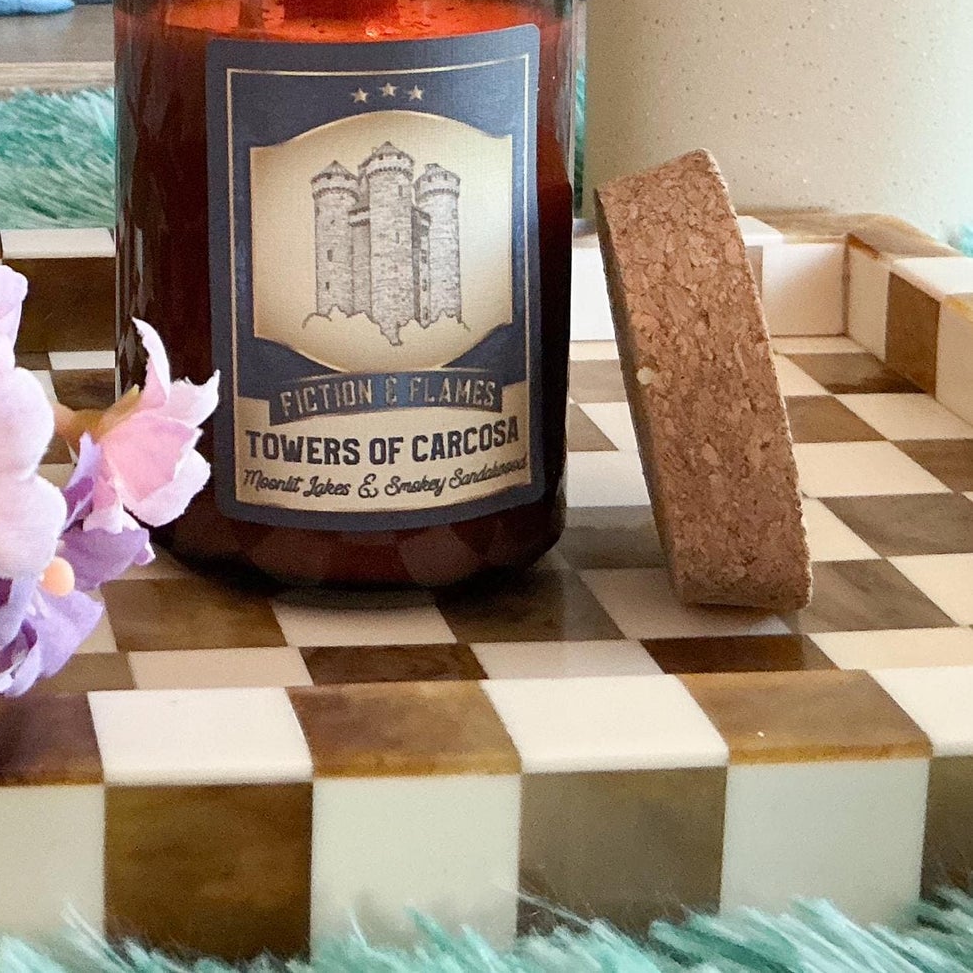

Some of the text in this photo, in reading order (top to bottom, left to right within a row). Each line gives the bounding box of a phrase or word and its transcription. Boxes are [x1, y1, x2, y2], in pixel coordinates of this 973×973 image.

[280, 379, 374, 416] FICTION
[410, 377, 495, 407] FLAMES
[245, 415, 520, 466] TOWERS OF CARCOSA
[243, 469, 303, 493] Moonlit
[303, 475, 351, 498] Lakes
[385, 476, 447, 497] Smokey
